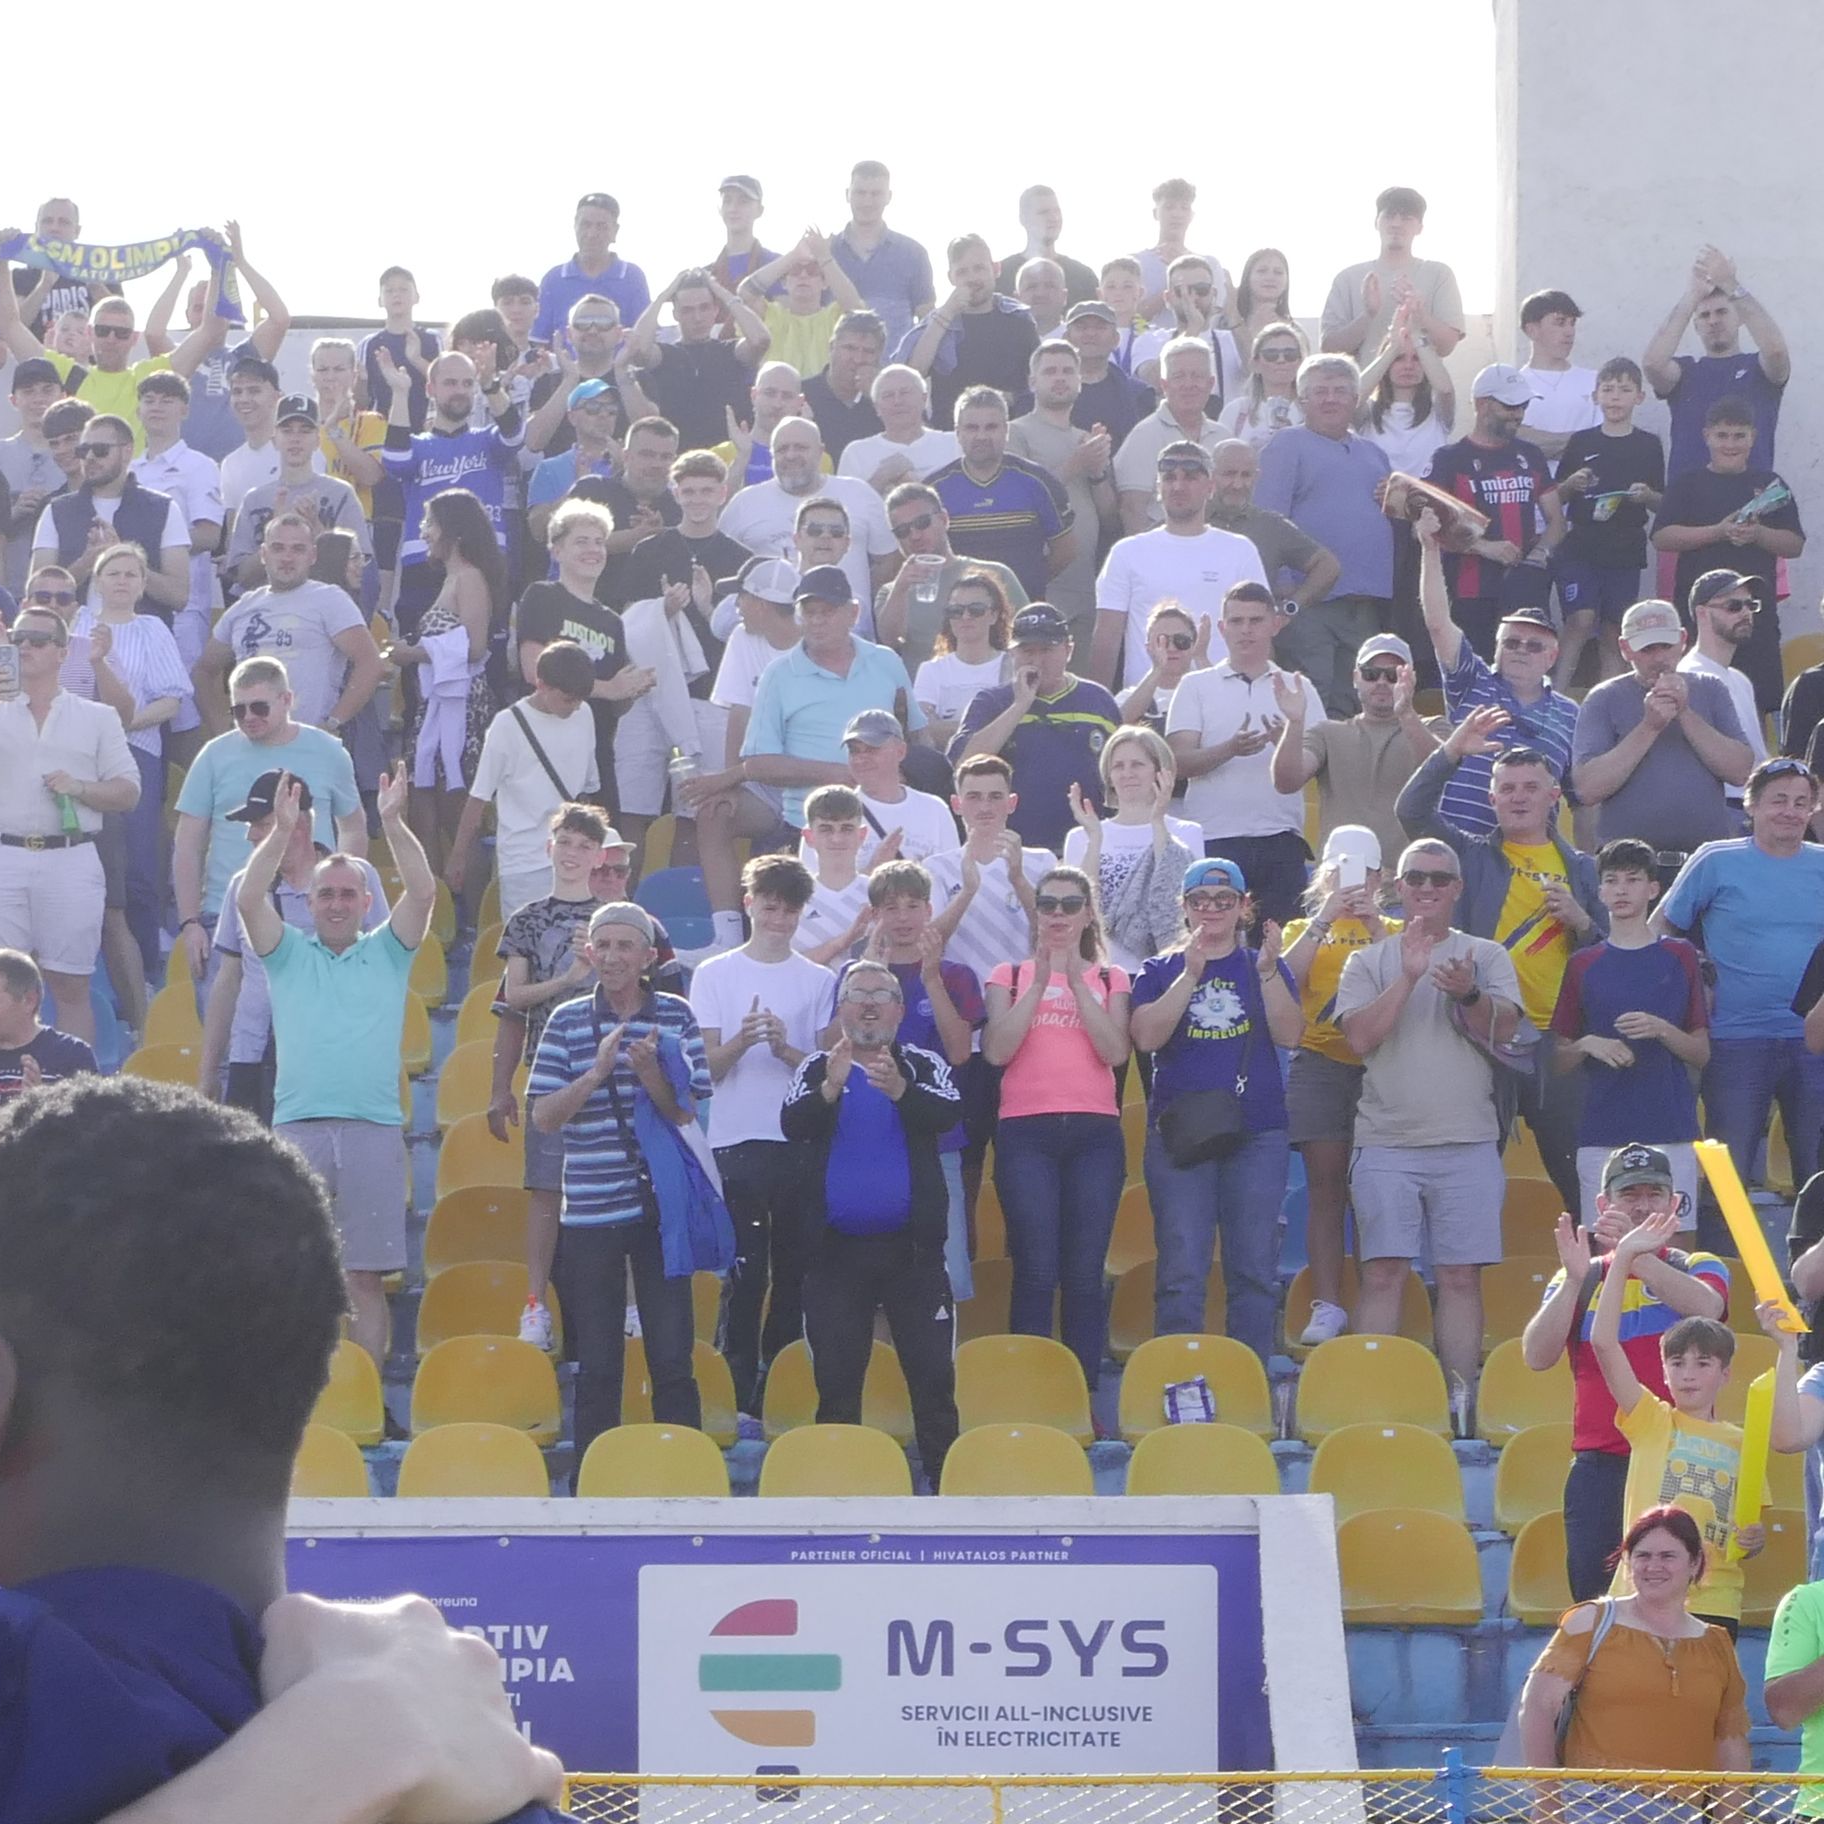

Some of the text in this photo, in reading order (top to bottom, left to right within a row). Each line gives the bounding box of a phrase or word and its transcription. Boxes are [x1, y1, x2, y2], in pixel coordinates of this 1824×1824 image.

[790, 1549, 1070, 1561] PARTENER OFICIAL HIVATALOS PARTNER
[886, 1618, 1170, 1679] M-SYS
[900, 1703, 1154, 1723] SERVICII ALL-INCLUSIVE
[936, 1725, 1122, 1749] ÎN ELECTRICITATE
